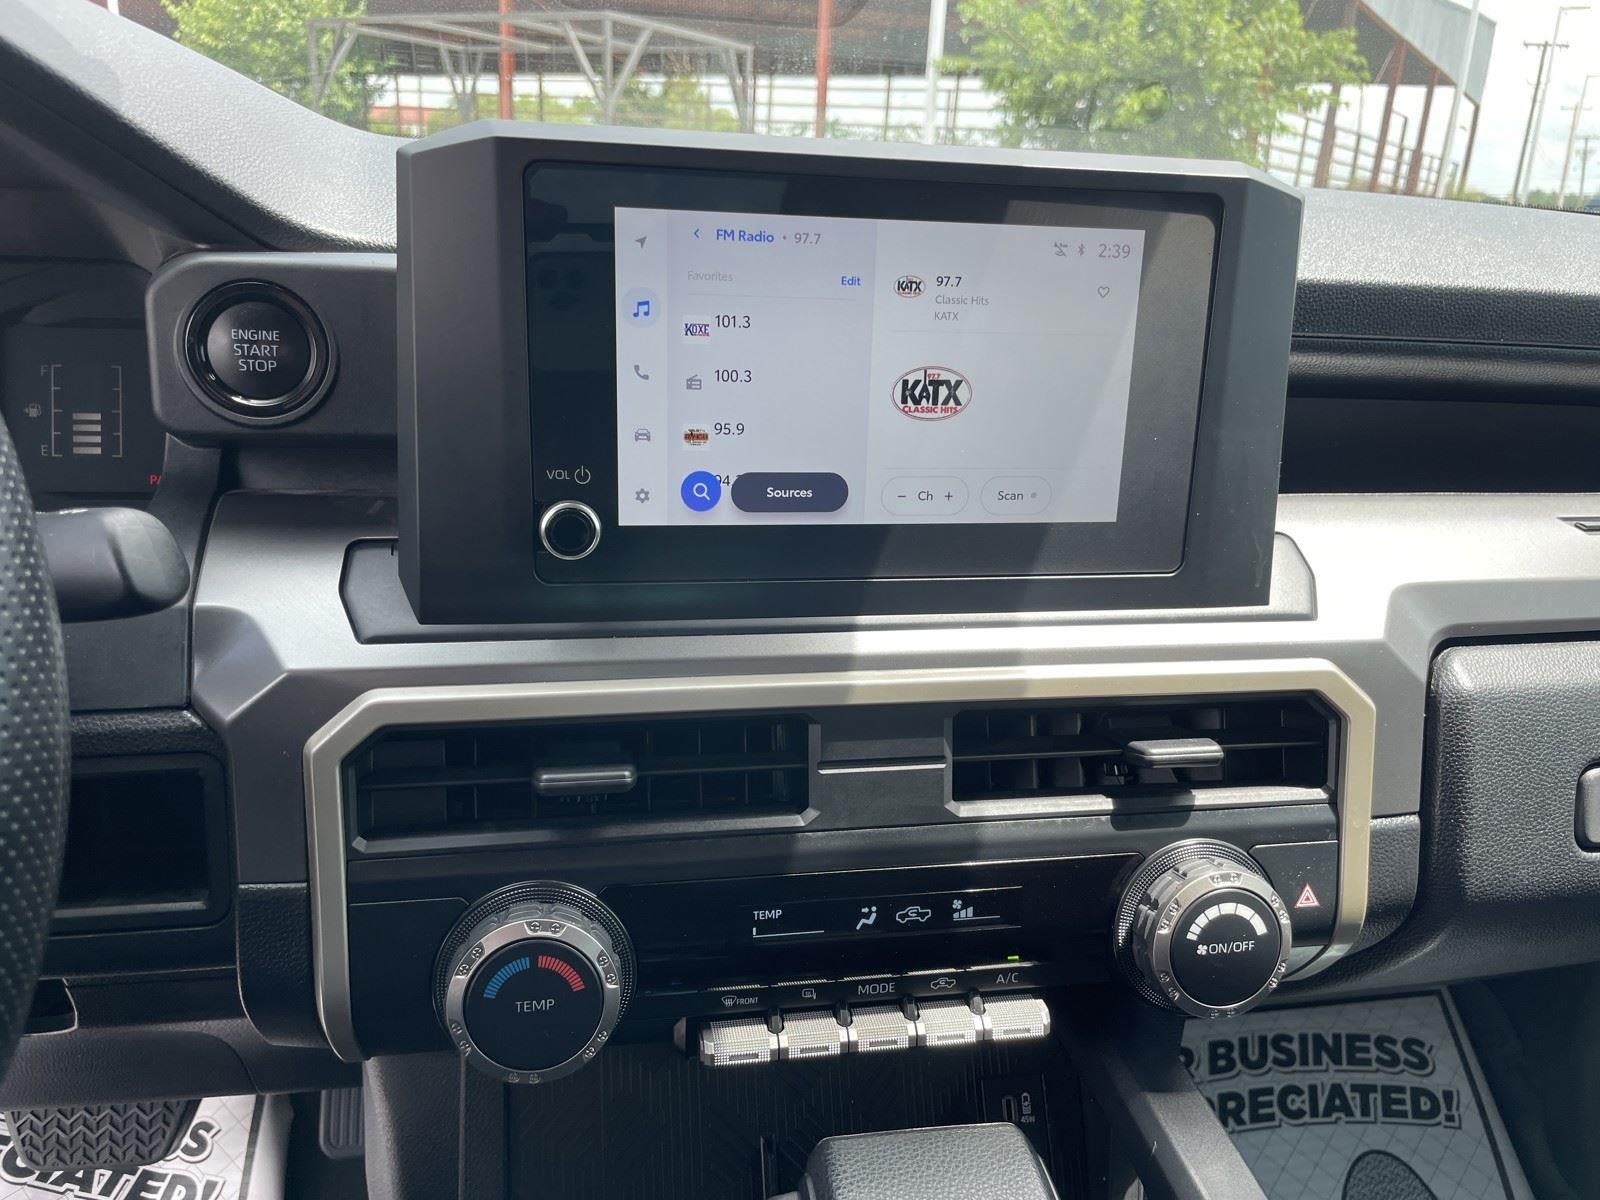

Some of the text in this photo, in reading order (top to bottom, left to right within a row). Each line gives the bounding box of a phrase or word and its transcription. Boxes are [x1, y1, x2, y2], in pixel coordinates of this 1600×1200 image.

[716, 228, 821, 245] FM Radio 97.7
[1098, 243, 1131, 259] 2:39
[687, 270, 733, 282] Favorites
[841, 275, 861, 287] Edit
[936, 275, 962, 288] 97.7
[935, 294, 989, 306] Classic Hits
[715, 314, 751, 329] 101.3
[934, 311, 959, 321] KATX
[231, 328, 280, 342] ENGINE
[233, 343, 280, 357] START
[40, 364, 49, 376] F
[238, 358, 277, 372] STOP
[714, 369, 752, 383] 100.3
[900, 371, 964, 407] KATX
[902, 405, 960, 414] CLASSIC HITS
[714, 422, 745, 436] 95.9
[40, 444, 49, 457] E
[546, 469, 570, 480] VOL
[766, 487, 813, 498] Sources
[918, 490, 934, 501] Ch
[997, 490, 1024, 501] Scan
[753, 909, 782, 921] TEMP
[1208, 940, 1256, 955] ON/OFF
[996, 972, 1020, 985] A/C
[858, 982, 896, 996] MODE
[515, 999, 555, 1013] TEMP
[736, 996, 759, 1005] FRONT
[1207, 1032, 1430, 1076] BUSINESS
[1204, 1083, 1457, 1127] RECIATED!
